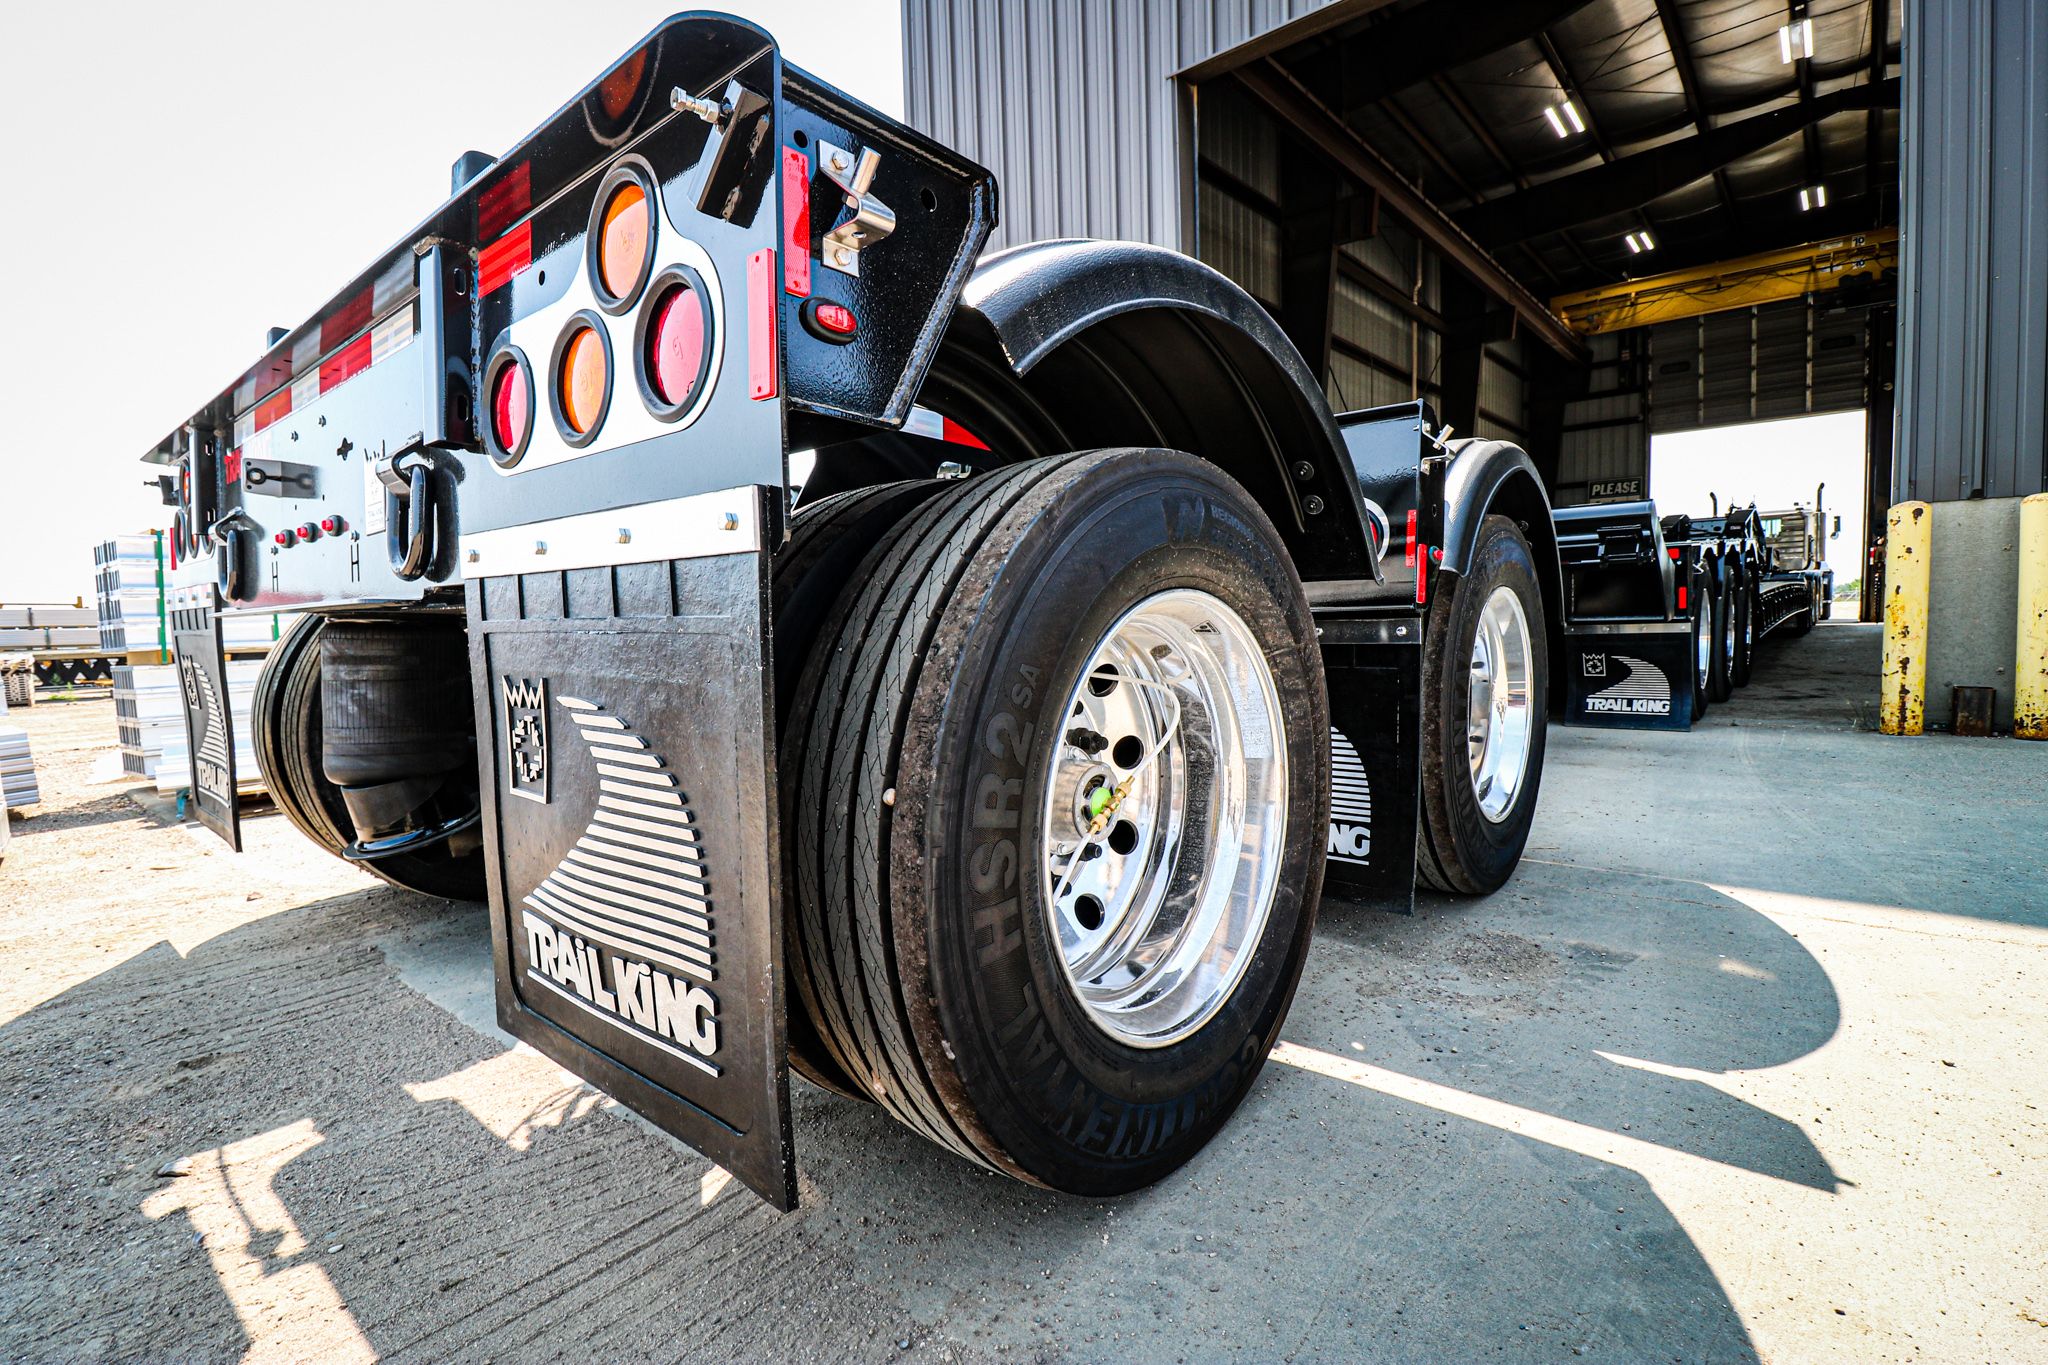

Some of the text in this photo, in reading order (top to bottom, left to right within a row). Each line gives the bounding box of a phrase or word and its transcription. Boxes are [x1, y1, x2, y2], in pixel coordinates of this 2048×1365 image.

[1852, 236, 1865, 247] 10
[1591, 480, 1639, 496] PLEASE
[1012, 663, 1042, 709] SA
[1327, 822, 1371, 857] NG
